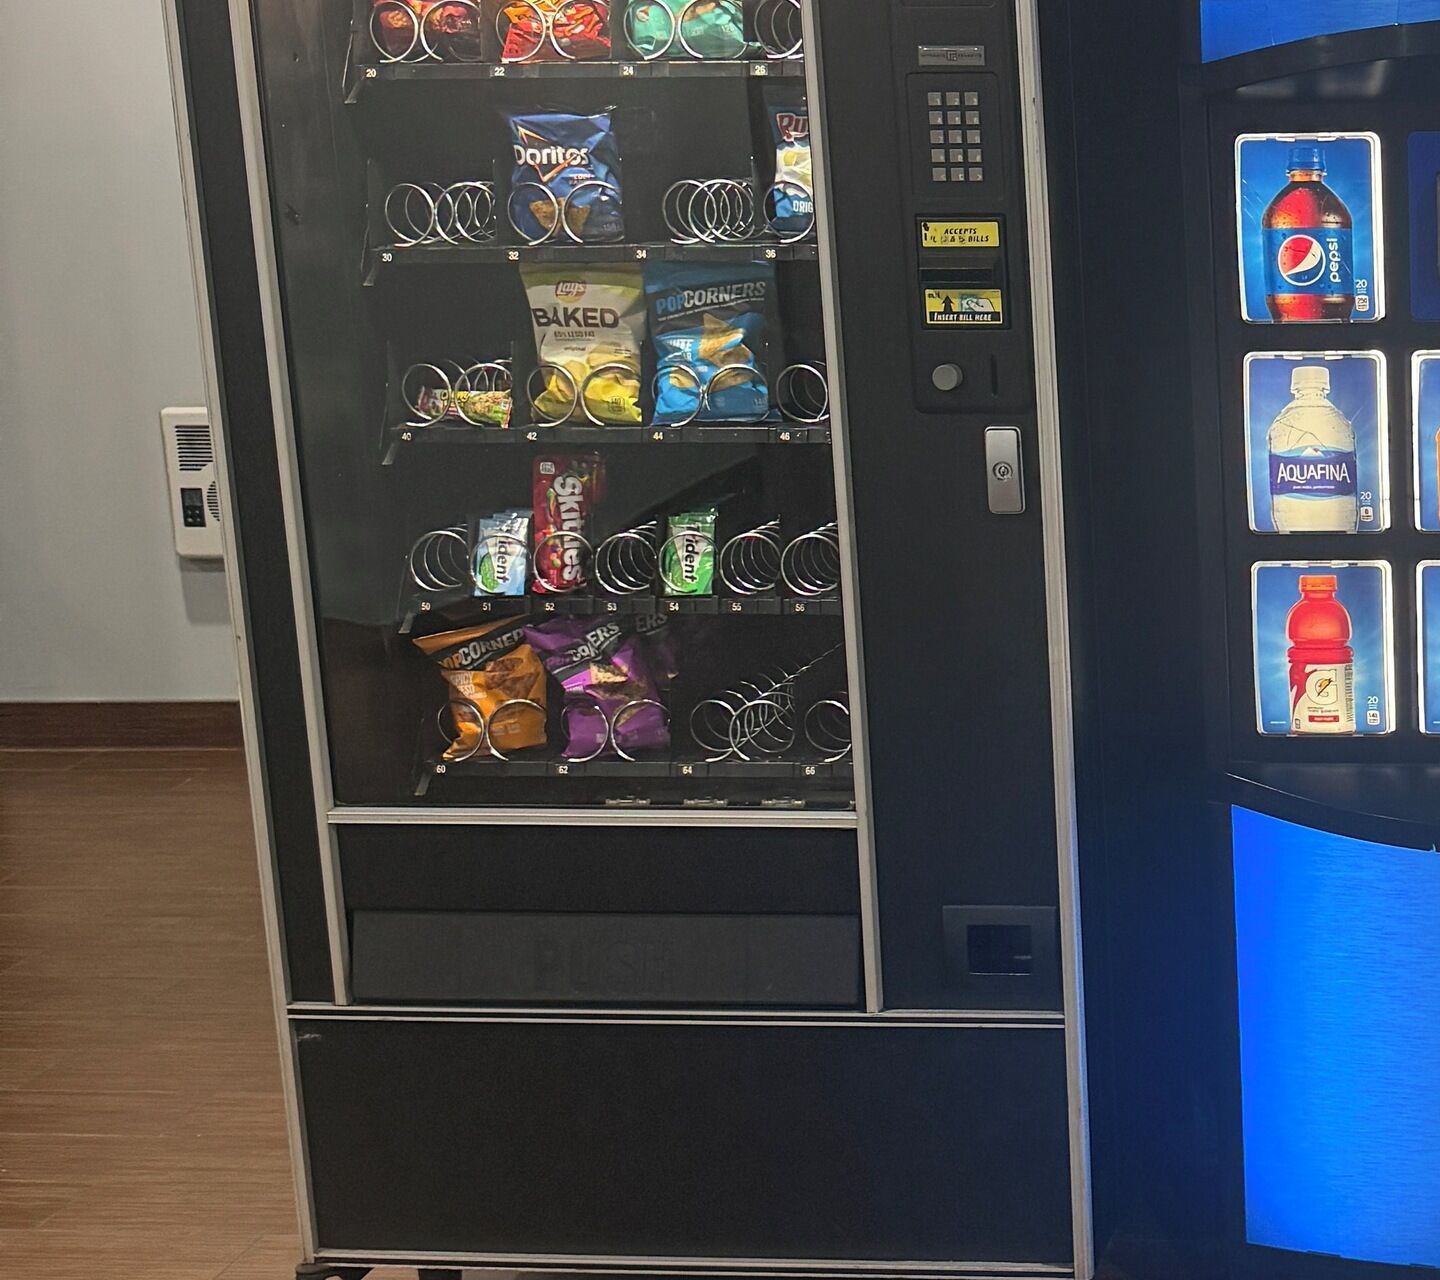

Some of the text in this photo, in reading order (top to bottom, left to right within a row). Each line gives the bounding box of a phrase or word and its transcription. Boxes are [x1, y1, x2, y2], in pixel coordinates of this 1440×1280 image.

[366, 68, 377, 77] 20
[494, 67, 505, 76] 22
[623, 66, 634, 76] 24
[755, 65, 766, 74] 26
[512, 144, 589, 166] Doritos
[382, 253, 392, 262] 30
[509, 251, 519, 261] 32
[636, 250, 646, 260] 34
[766, 249, 776, 259] 36
[1326, 237, 1342, 283] pepsi
[1356, 279, 1368, 289] 20
[655, 282, 766, 315] POPCORNERS
[531, 306, 620, 328] BAKED
[934, 312, 992, 321] INSERT BILL HERE
[402, 431, 412, 442] 40
[527, 431, 537, 441] 42
[653, 431, 664, 441] 44
[780, 431, 790, 441] 46
[1277, 462, 1351, 484] AQUAFINA
[1360, 491, 1372, 500] 20
[421, 602, 431, 612] 50
[483, 602, 492, 611] 51
[545, 602, 555, 612] 52
[607, 602, 617, 612] 53
[669, 602, 679, 612] 54
[732, 602, 742, 612] 55
[796, 602, 805, 612] 56
[1305, 669, 1338, 706] G
[1367, 696, 1379, 705] 20
[436, 765, 446, 774] 60
[558, 765, 568, 774] 62
[683, 765, 692, 775] 64
[805, 766, 816, 775] 66
